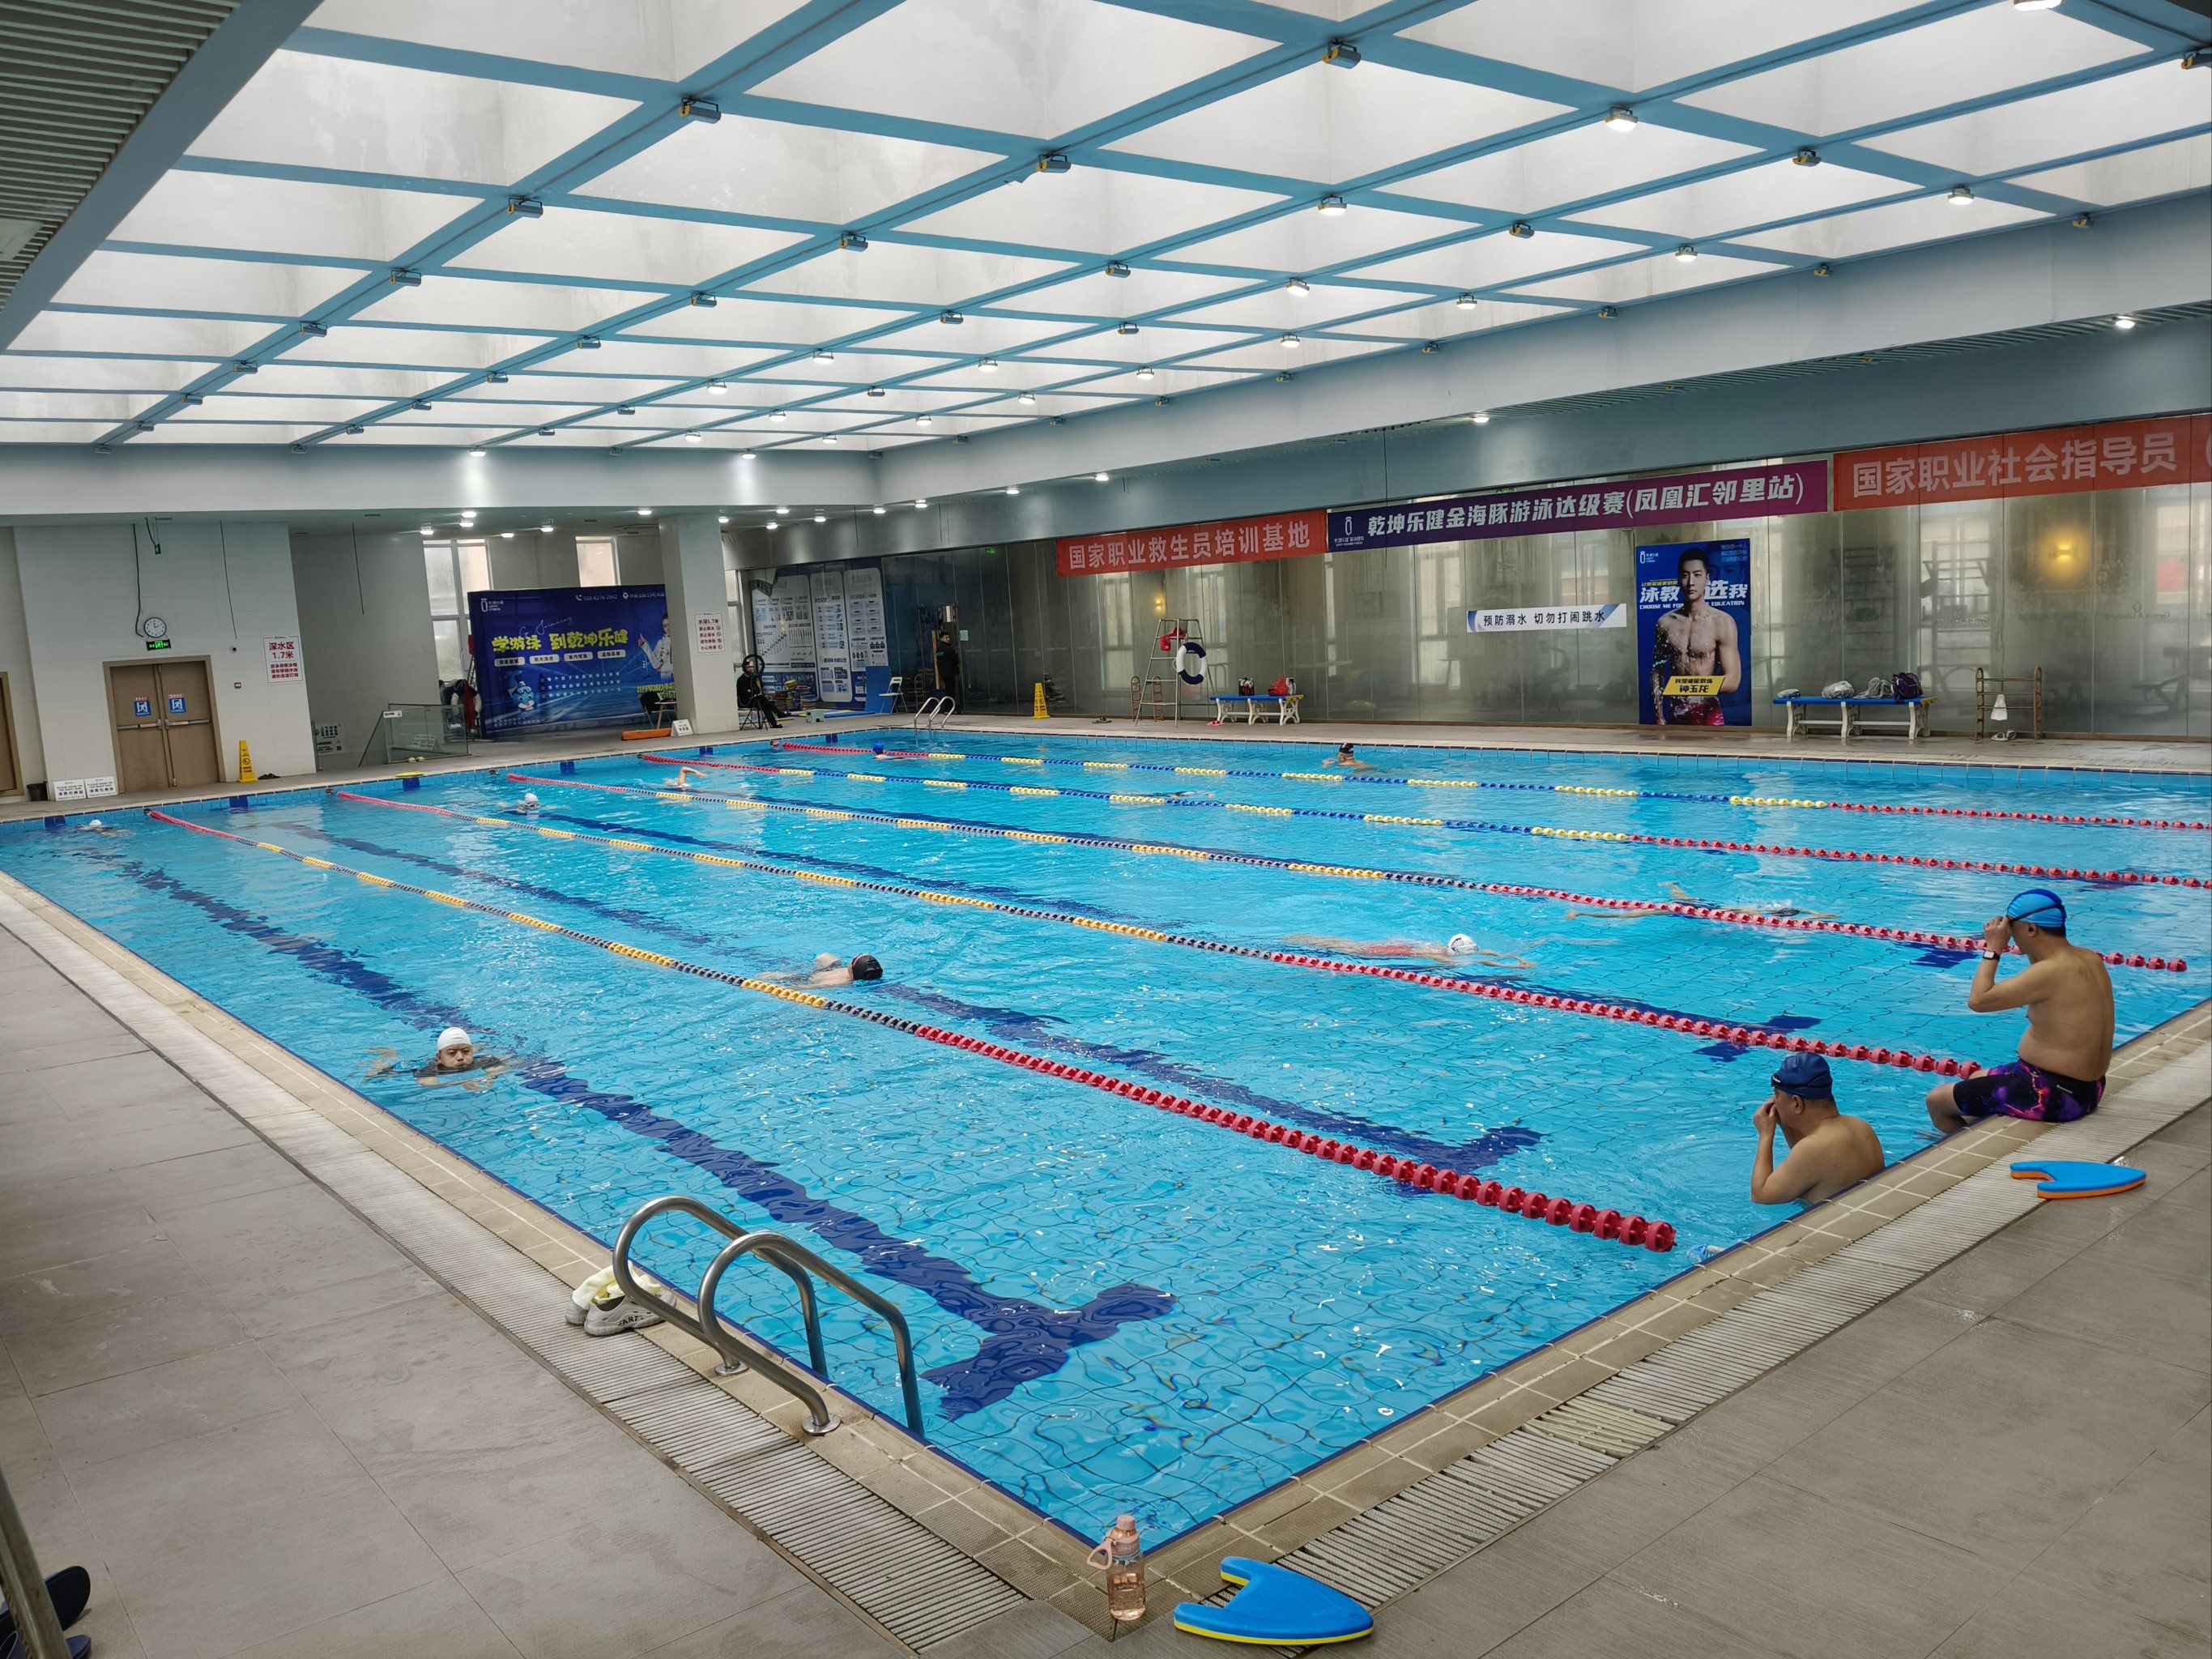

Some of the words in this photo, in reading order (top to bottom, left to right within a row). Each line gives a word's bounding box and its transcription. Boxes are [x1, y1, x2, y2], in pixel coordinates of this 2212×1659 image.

[1852, 431, 2177, 498] 国家职业社会指导员
[1068, 520, 1311, 570] 国家职业救生员培训基地
[1639, 586, 1681, 603] 泳教
[1704, 580, 1748, 599] 选我
[1484, 613, 1527, 626] 预防溺水
[1534, 610, 1605, 625] 切勿打闹跳水
[269, 642, 294, 650] 深水区
[492, 635, 541, 653] 学游泳
[549, 628, 629, 650] 到乾坤乐健
[272, 651, 293, 659] 1.7米
[1680, 684, 1709, 693] 钟玉龙
